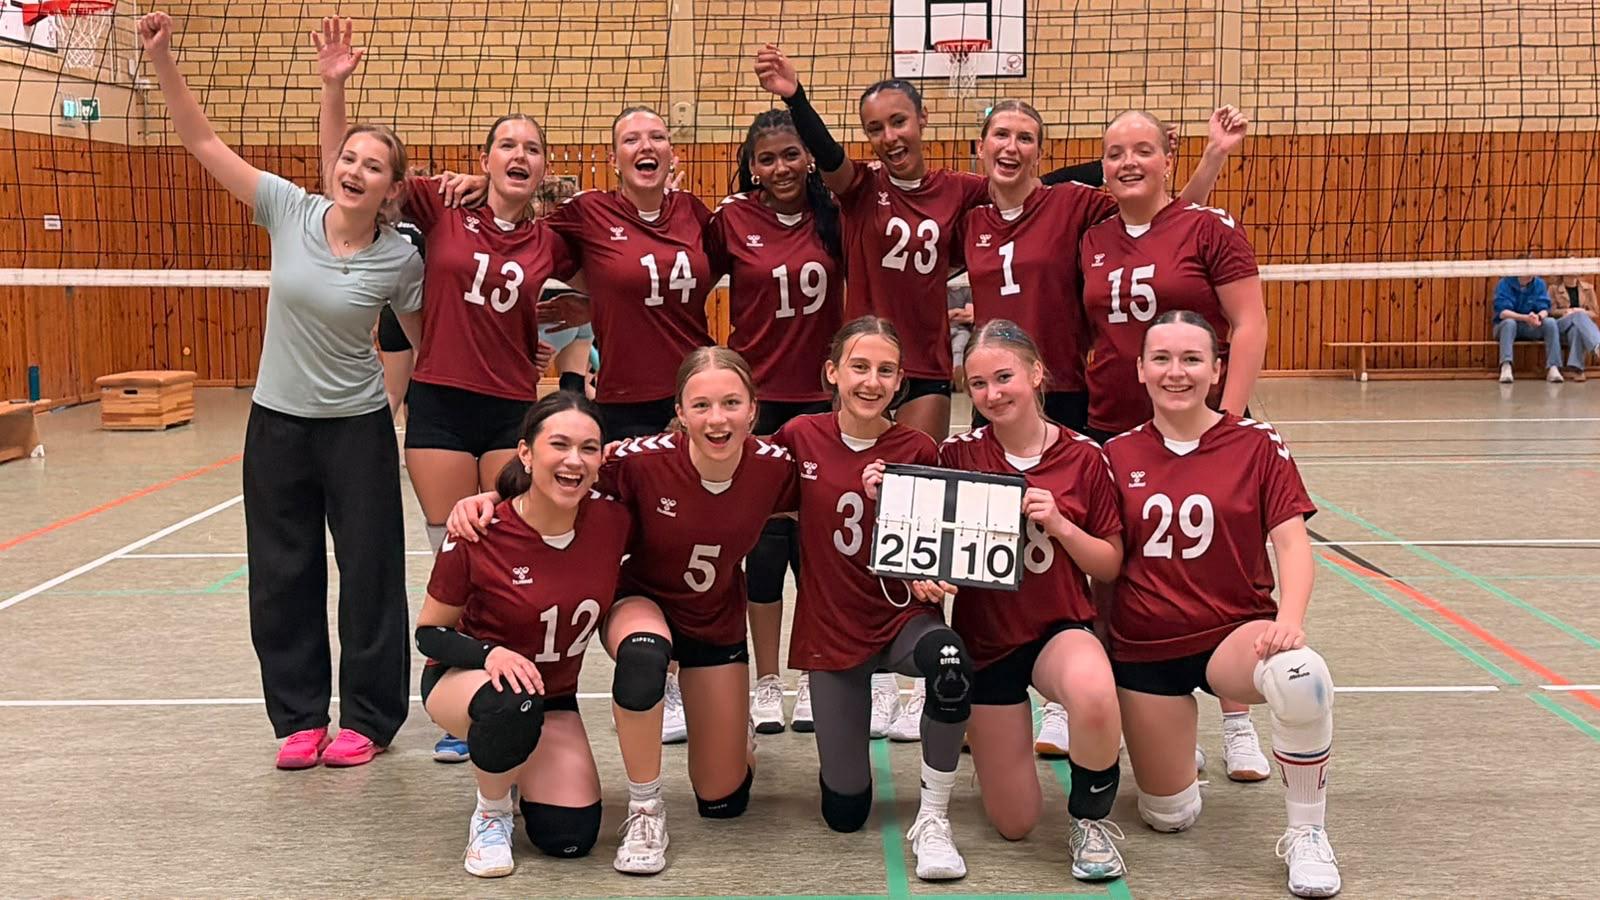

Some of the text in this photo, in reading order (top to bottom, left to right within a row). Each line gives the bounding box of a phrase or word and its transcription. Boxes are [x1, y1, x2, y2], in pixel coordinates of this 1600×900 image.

[881, 216, 940, 275] 23
[998, 241, 1021, 296] 1
[464, 252, 524, 313] 13
[640, 250, 697, 306] 14
[772, 261, 828, 319] 19
[1107, 264, 1157, 323] 15
[833, 491, 864, 556] 3
[1142, 493, 1214, 559] 29
[683, 544, 722, 592] 5
[879, 533, 1015, 578] 25 10
[535, 599, 600, 663] 12
